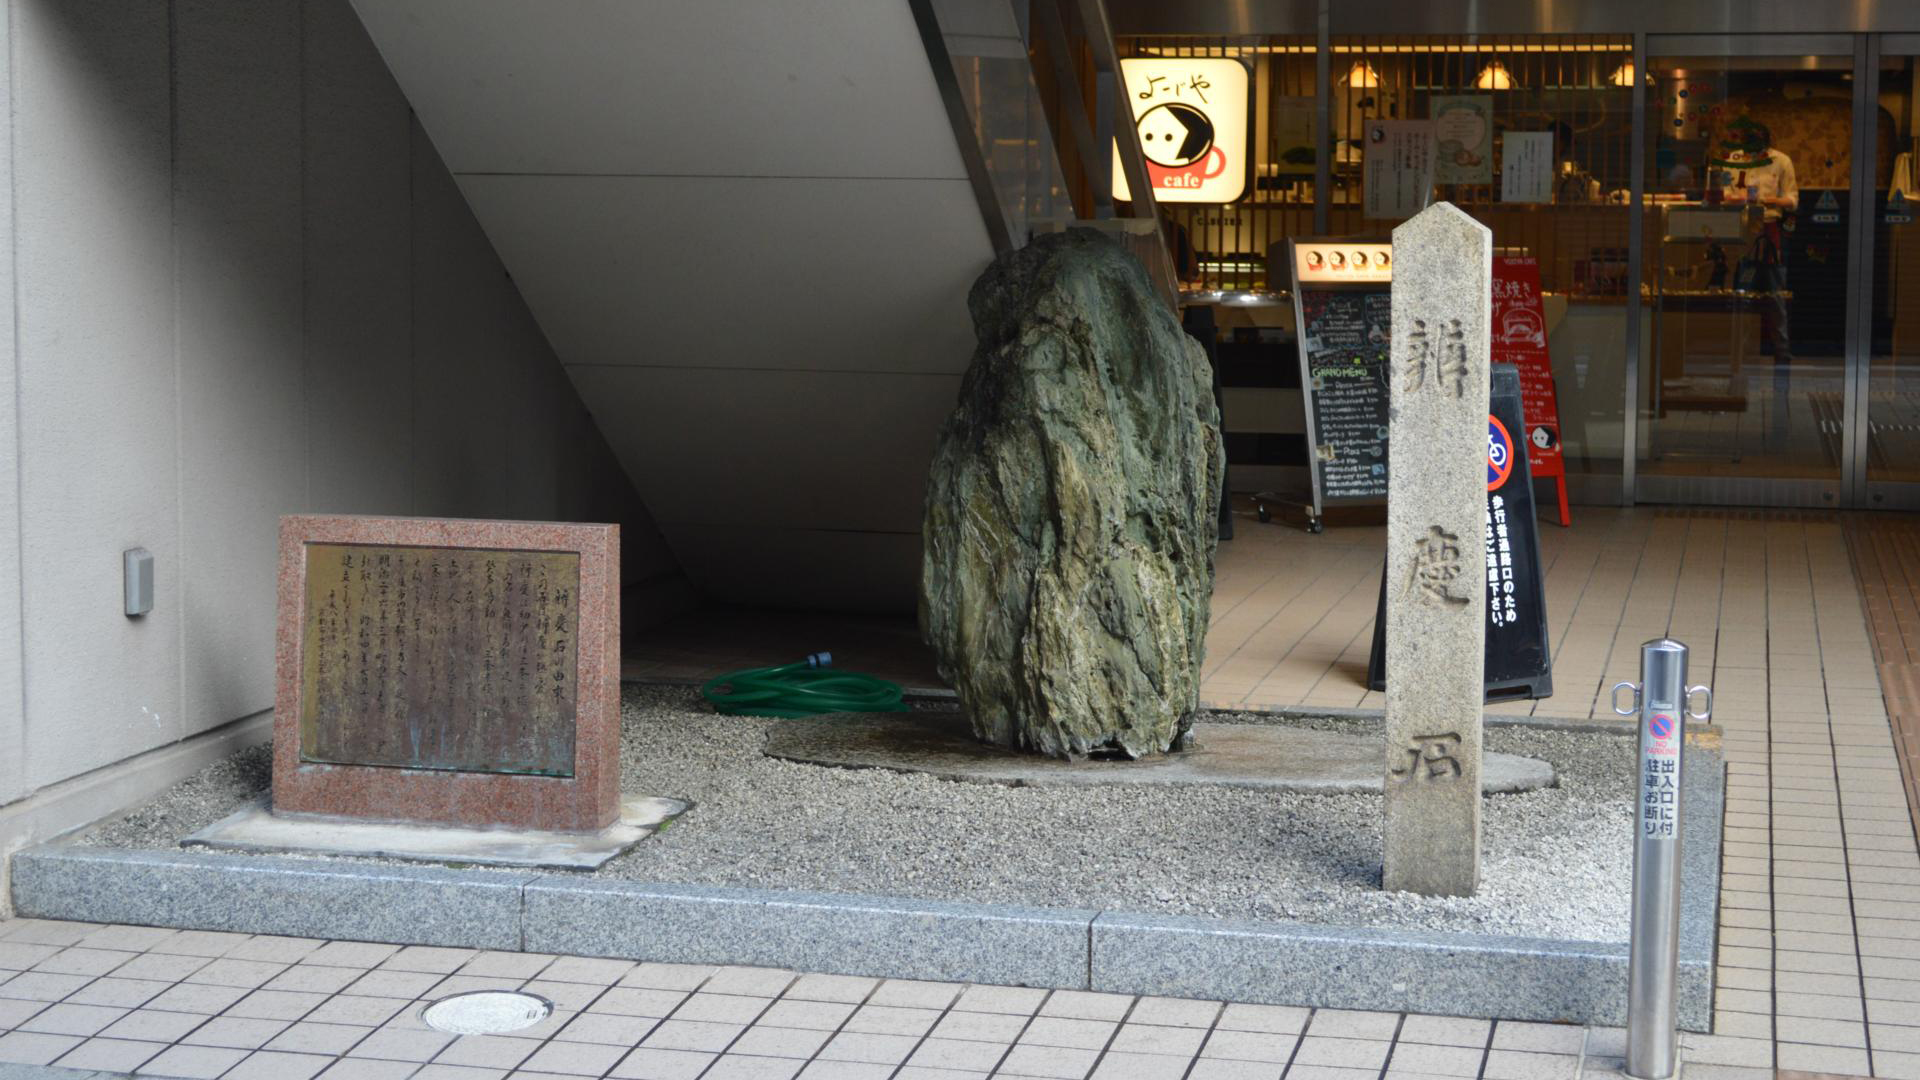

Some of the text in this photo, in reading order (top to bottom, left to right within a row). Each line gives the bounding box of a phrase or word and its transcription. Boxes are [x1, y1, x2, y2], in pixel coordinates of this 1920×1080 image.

[1138, 73, 1211, 104] よーじや
[1163, 173, 1200, 187] cafe
[1312, 367, 1341, 377] GRAND
[1486, 499, 1504, 627] はご遠慮下さい。
[1491, 495, 1517, 623] 歩行者通路口のため
[1644, 759, 1660, 836] 駐車お断り
[1658, 759, 1675, 836] 出入口に付
